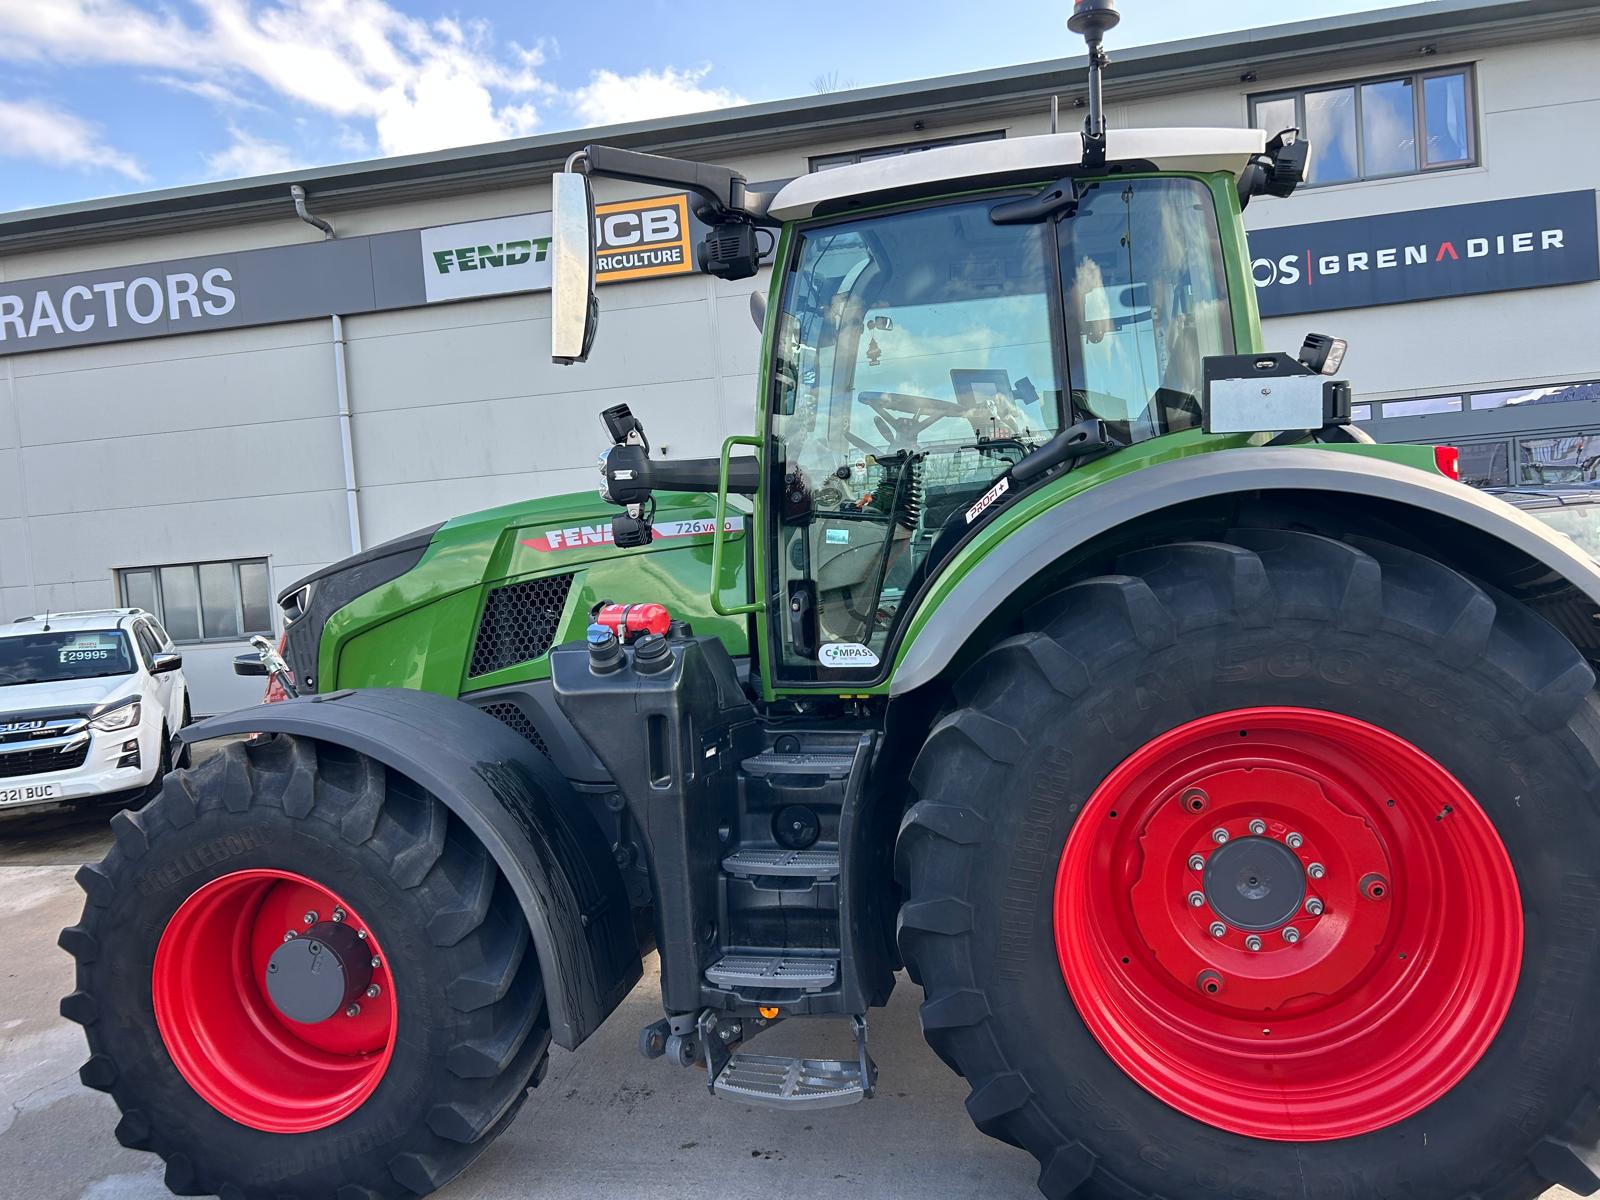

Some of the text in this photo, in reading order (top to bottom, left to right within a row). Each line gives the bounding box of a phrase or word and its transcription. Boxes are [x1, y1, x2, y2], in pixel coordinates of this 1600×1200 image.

[596, 209, 679, 247] CB
[433, 237, 552, 274] FENDT
[596, 249, 681, 271] RICULTURE
[1319, 229, 1564, 275] GRENADIER
[0, 267, 236, 341] RACTORS
[676, 521, 701, 534] 726
[60, 650, 108, 663] £29995
[26, 785, 53, 799] BUC
